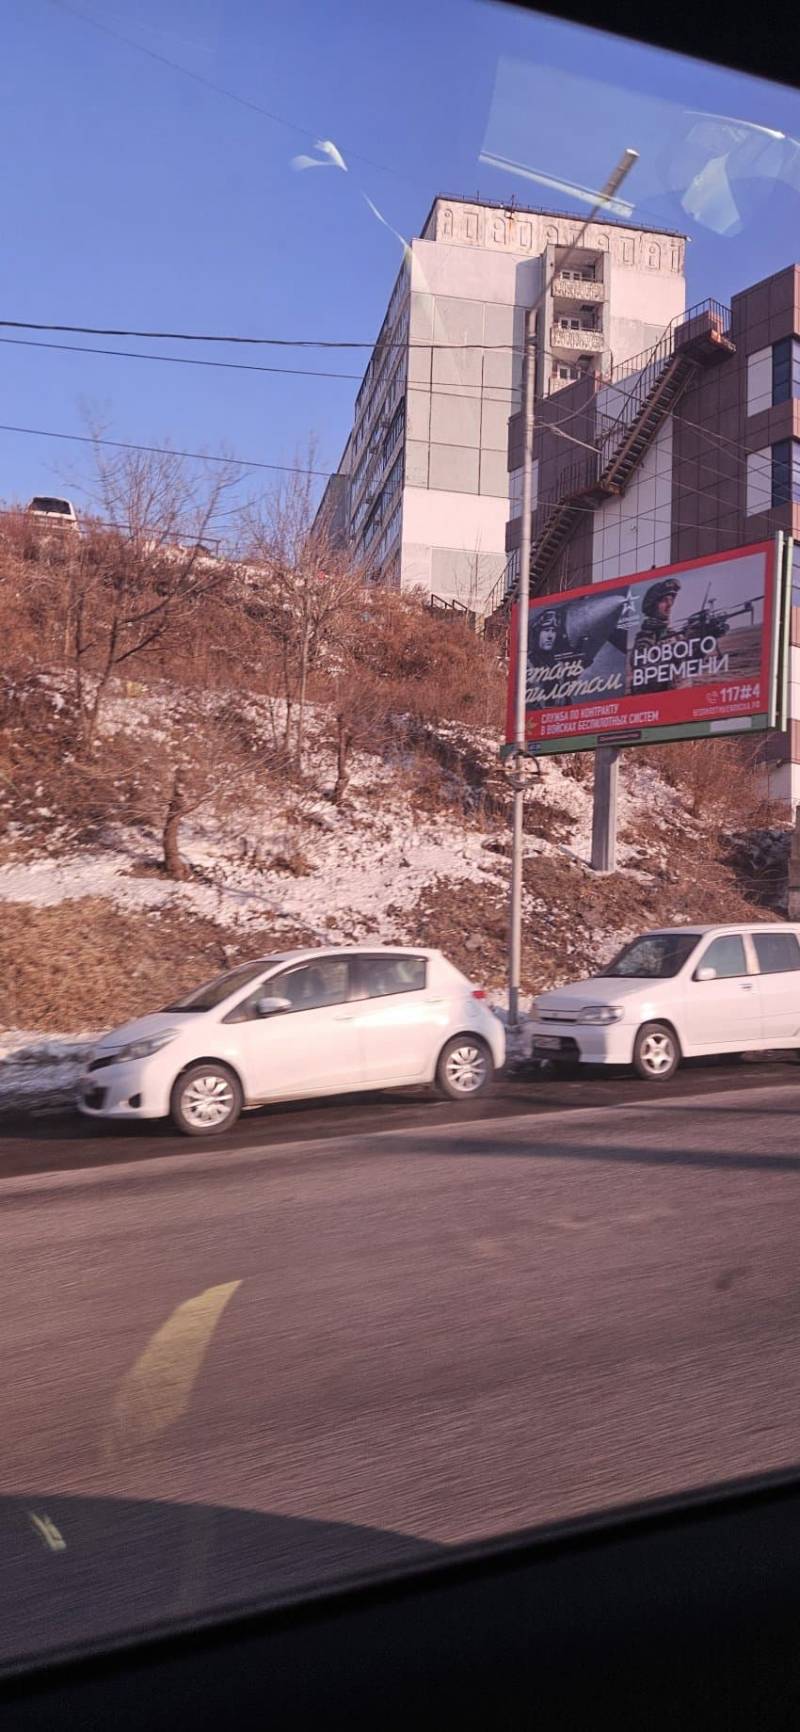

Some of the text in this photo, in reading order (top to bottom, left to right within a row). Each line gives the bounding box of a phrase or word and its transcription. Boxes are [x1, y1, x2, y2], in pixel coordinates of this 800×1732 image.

[634, 635, 717, 667] НОВОГО
[632, 654, 730, 687] ВРЕМЕНИ
[720, 683, 761, 704] 117#4
[540, 708, 569, 725] СЛУЖБА
[569, 708, 580, 721] ПО
